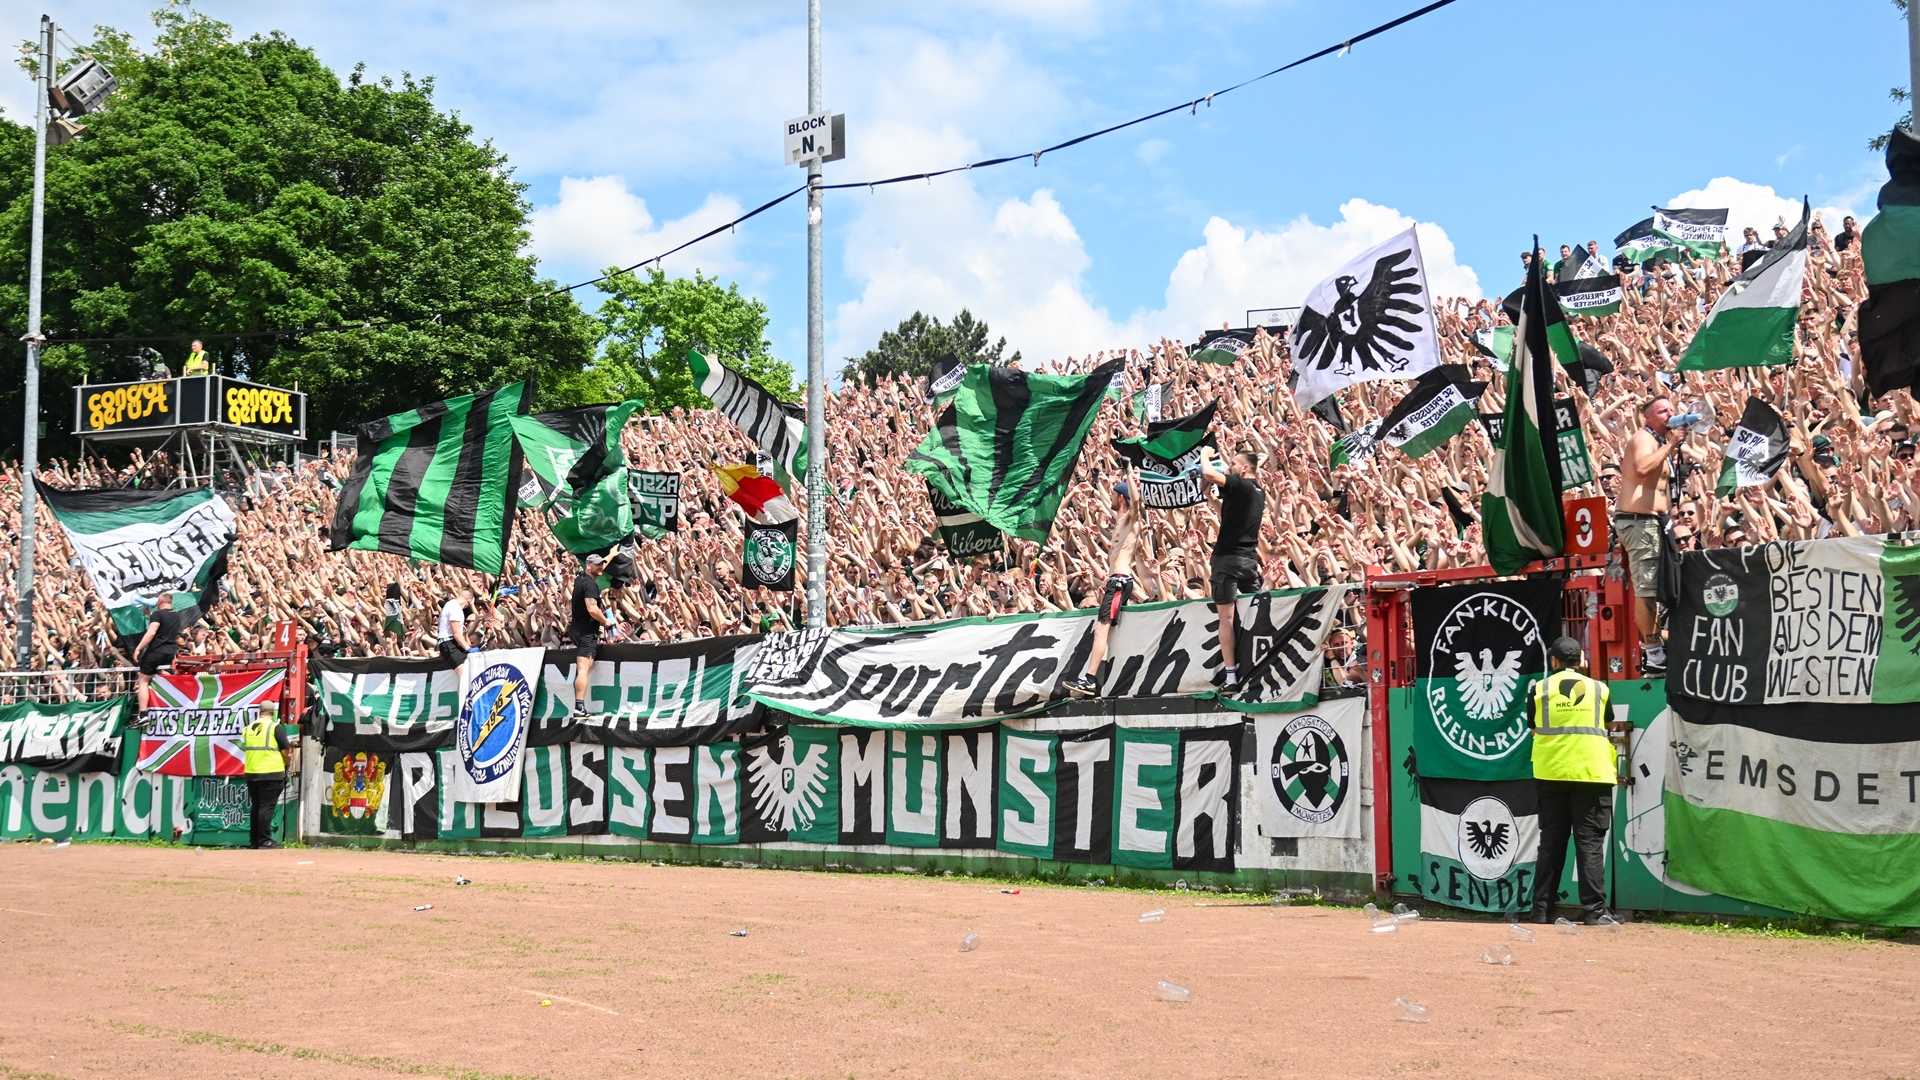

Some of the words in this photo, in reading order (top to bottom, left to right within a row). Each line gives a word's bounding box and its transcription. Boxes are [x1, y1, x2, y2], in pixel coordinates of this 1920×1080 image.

[788, 115, 826, 135] BLOCK
[802, 134, 815, 154] N
[88, 381, 167, 412] condor
[226, 387, 292, 407] condor
[1737, 430, 1752, 444] SC
[629, 472, 678, 494] ORZA
[1575, 508, 1593, 547] 3
[1764, 541, 1809, 574] DIE
[1771, 567, 1882, 613] BESTEN
[280, 624, 290, 647] 4
[1435, 598, 1537, 655] FAN-KLUB
[1690, 614, 1744, 656] FAN
[1773, 609, 1821, 656] AUS
[1827, 610, 1883, 656] DEM
[1683, 658, 1748, 703] CLUB
[1767, 655, 1876, 698] WESTEN
[1432, 679, 1536, 755] RHEIN-RU
[840, 728, 1233, 859] MÜNSTER
